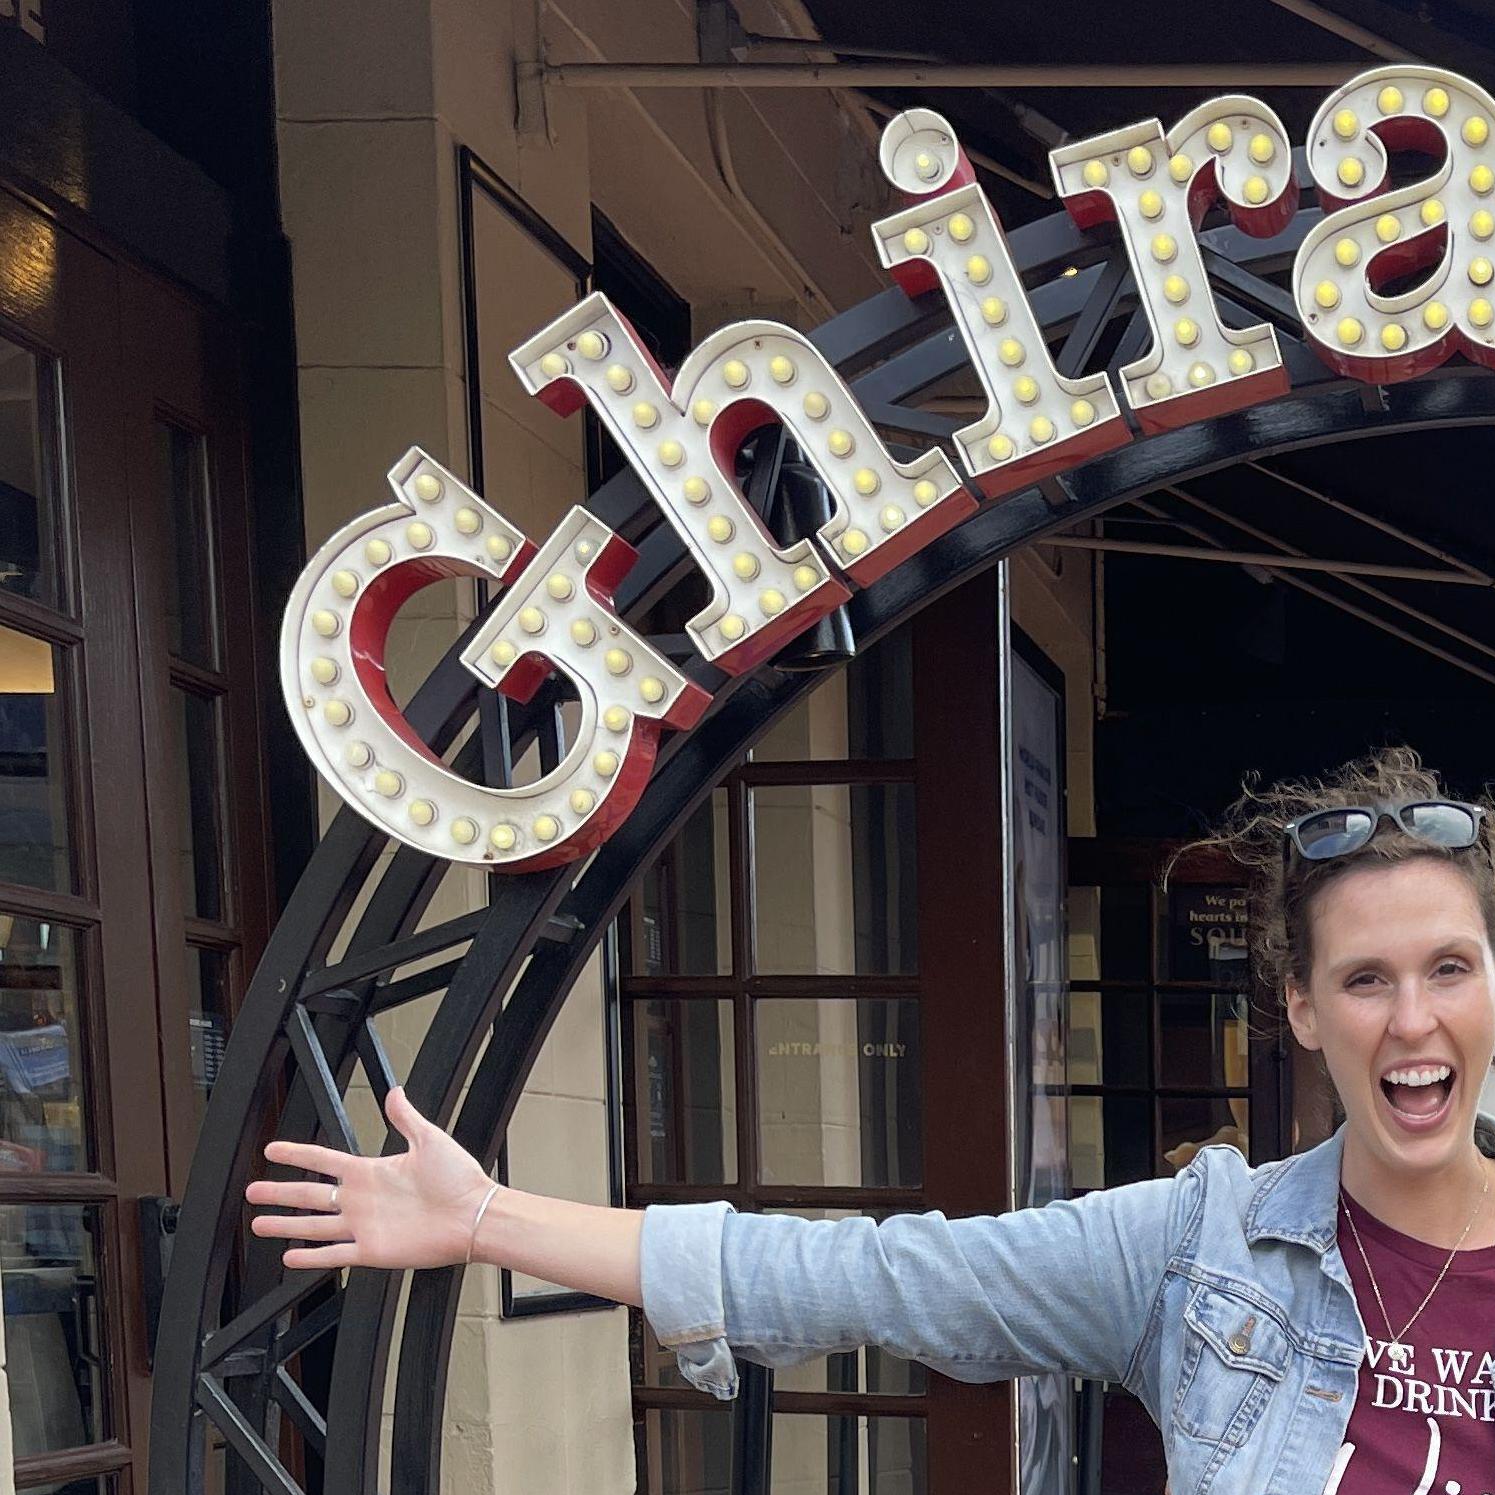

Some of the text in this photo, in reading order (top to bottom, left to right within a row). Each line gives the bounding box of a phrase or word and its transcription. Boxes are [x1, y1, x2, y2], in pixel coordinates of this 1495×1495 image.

[1229, 899, 1247, 910] po
[1235, 912, 1248, 922] in
[1190, 926, 1248, 946] SOU
[863, 1043, 907, 1058] ONLY
[1365, 1336, 1494, 1385] VE WA
